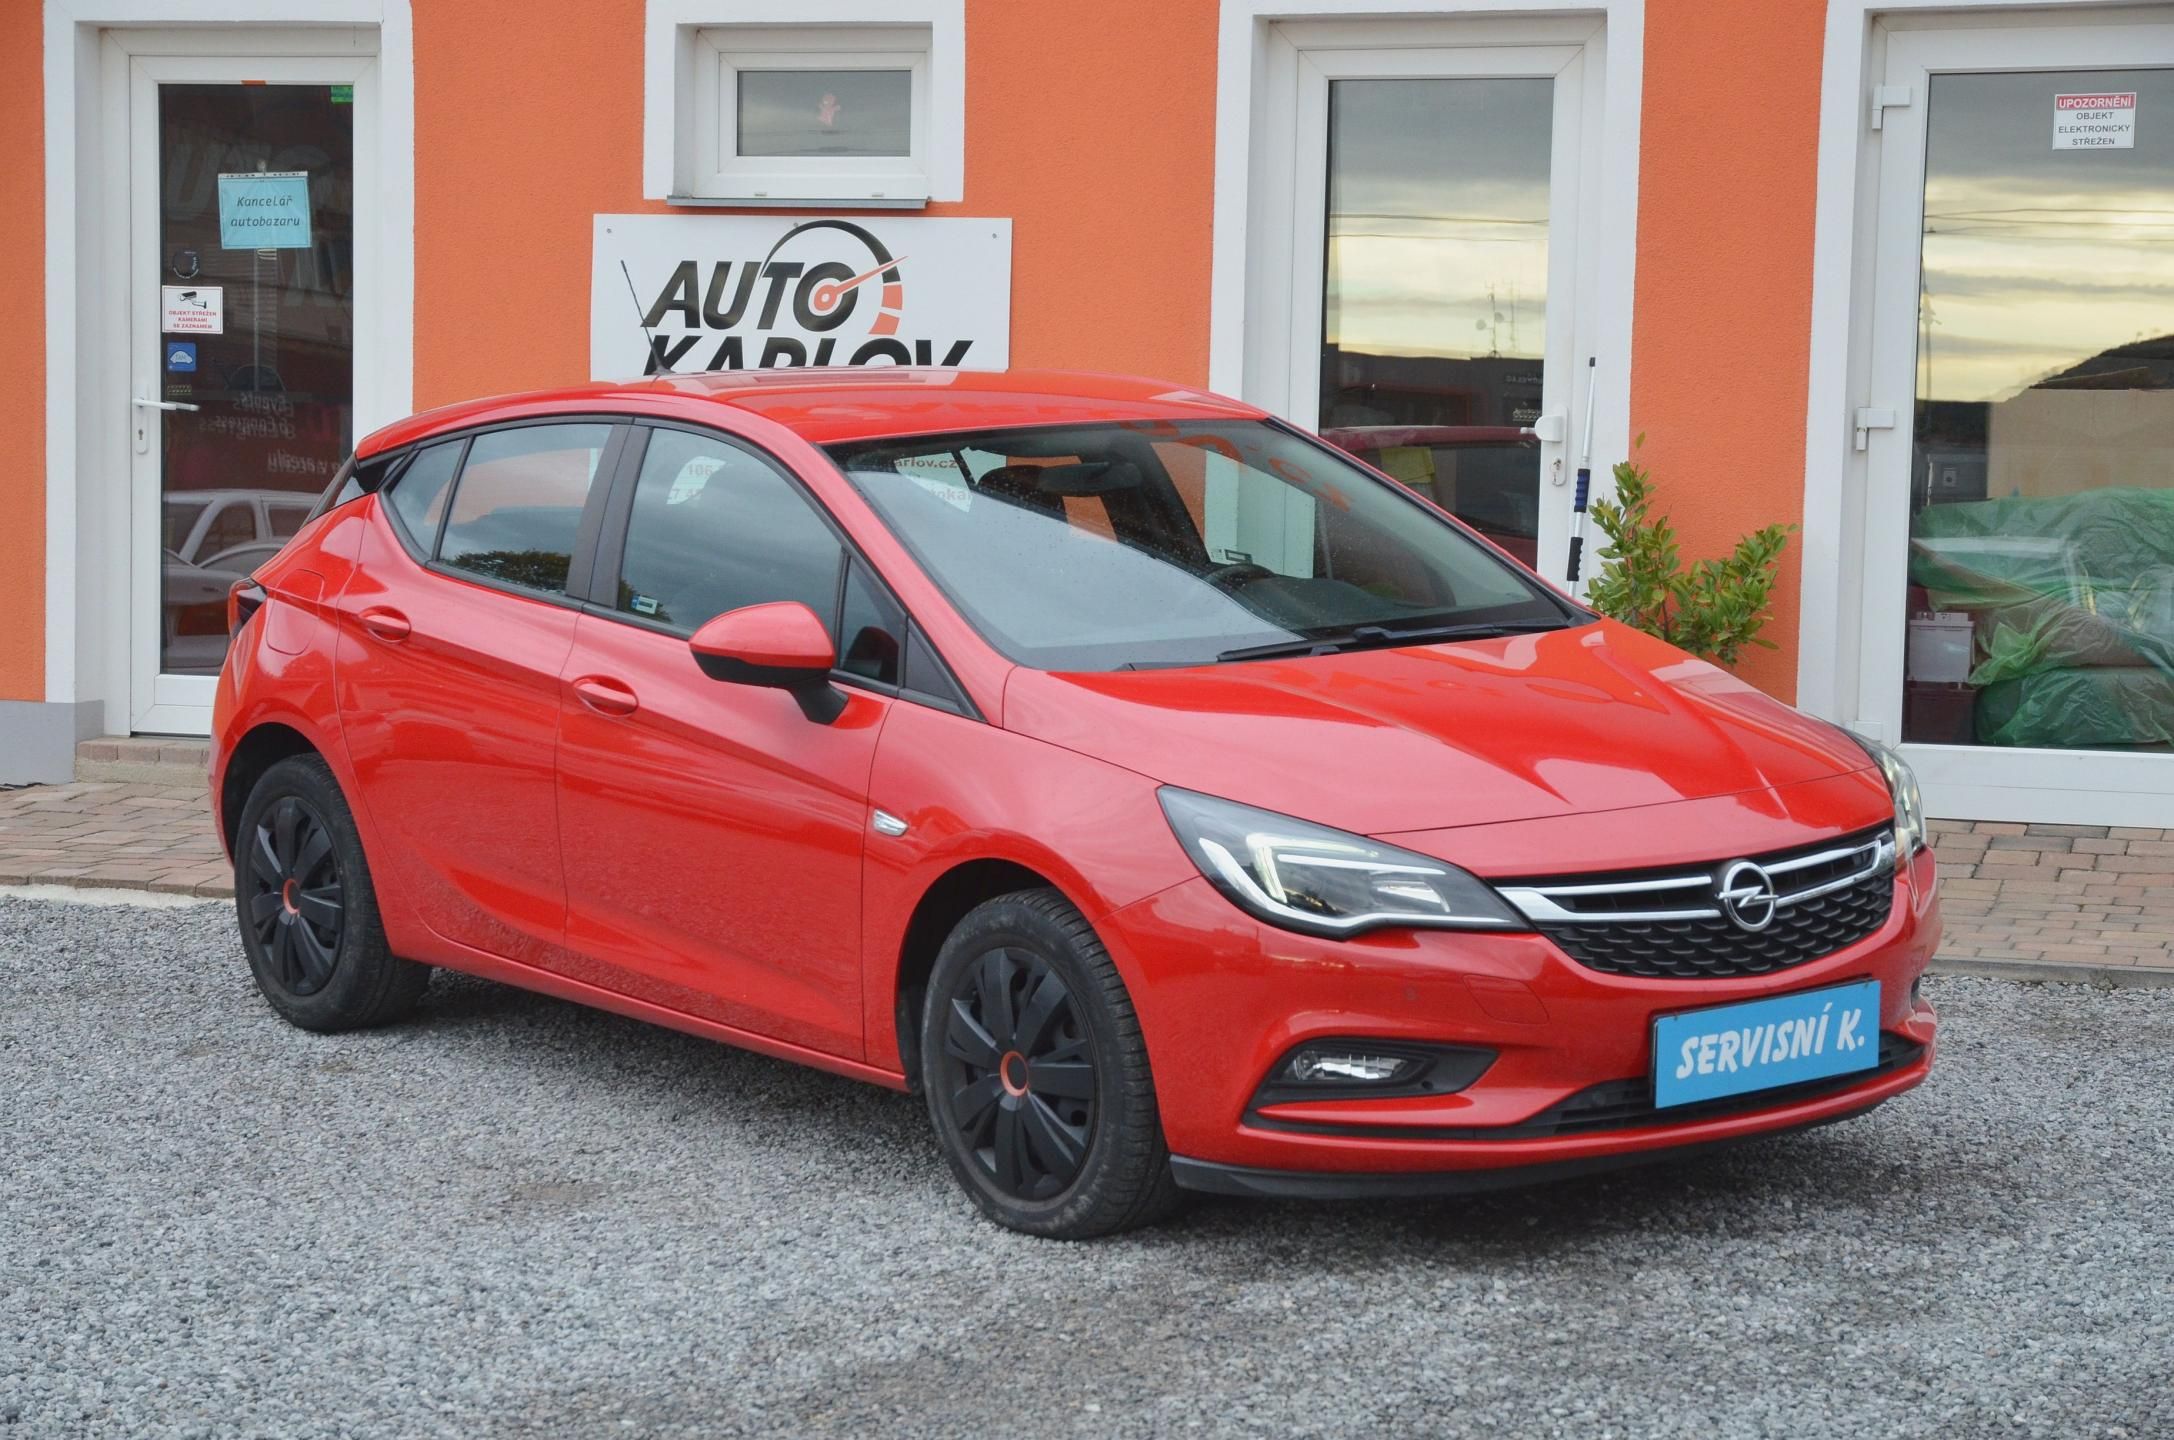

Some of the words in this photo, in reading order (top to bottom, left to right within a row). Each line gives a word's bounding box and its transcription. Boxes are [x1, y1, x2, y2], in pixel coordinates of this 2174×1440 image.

[2058, 95, 2132, 109] UPOZORNĚNÍ
[2076, 111, 2115, 120] OBJEKT
[2058, 124, 2130, 134] ELEKTRONICKY
[2072, 136, 2115, 146] STŘEŽEN
[236, 195, 293, 207] Kancelář
[230, 215, 300, 227] autobazaru
[640, 260, 859, 333] AUTO
[1675, 1002, 1833, 1080] SERVISNÍ
[1836, 1008, 1865, 1051] K.
